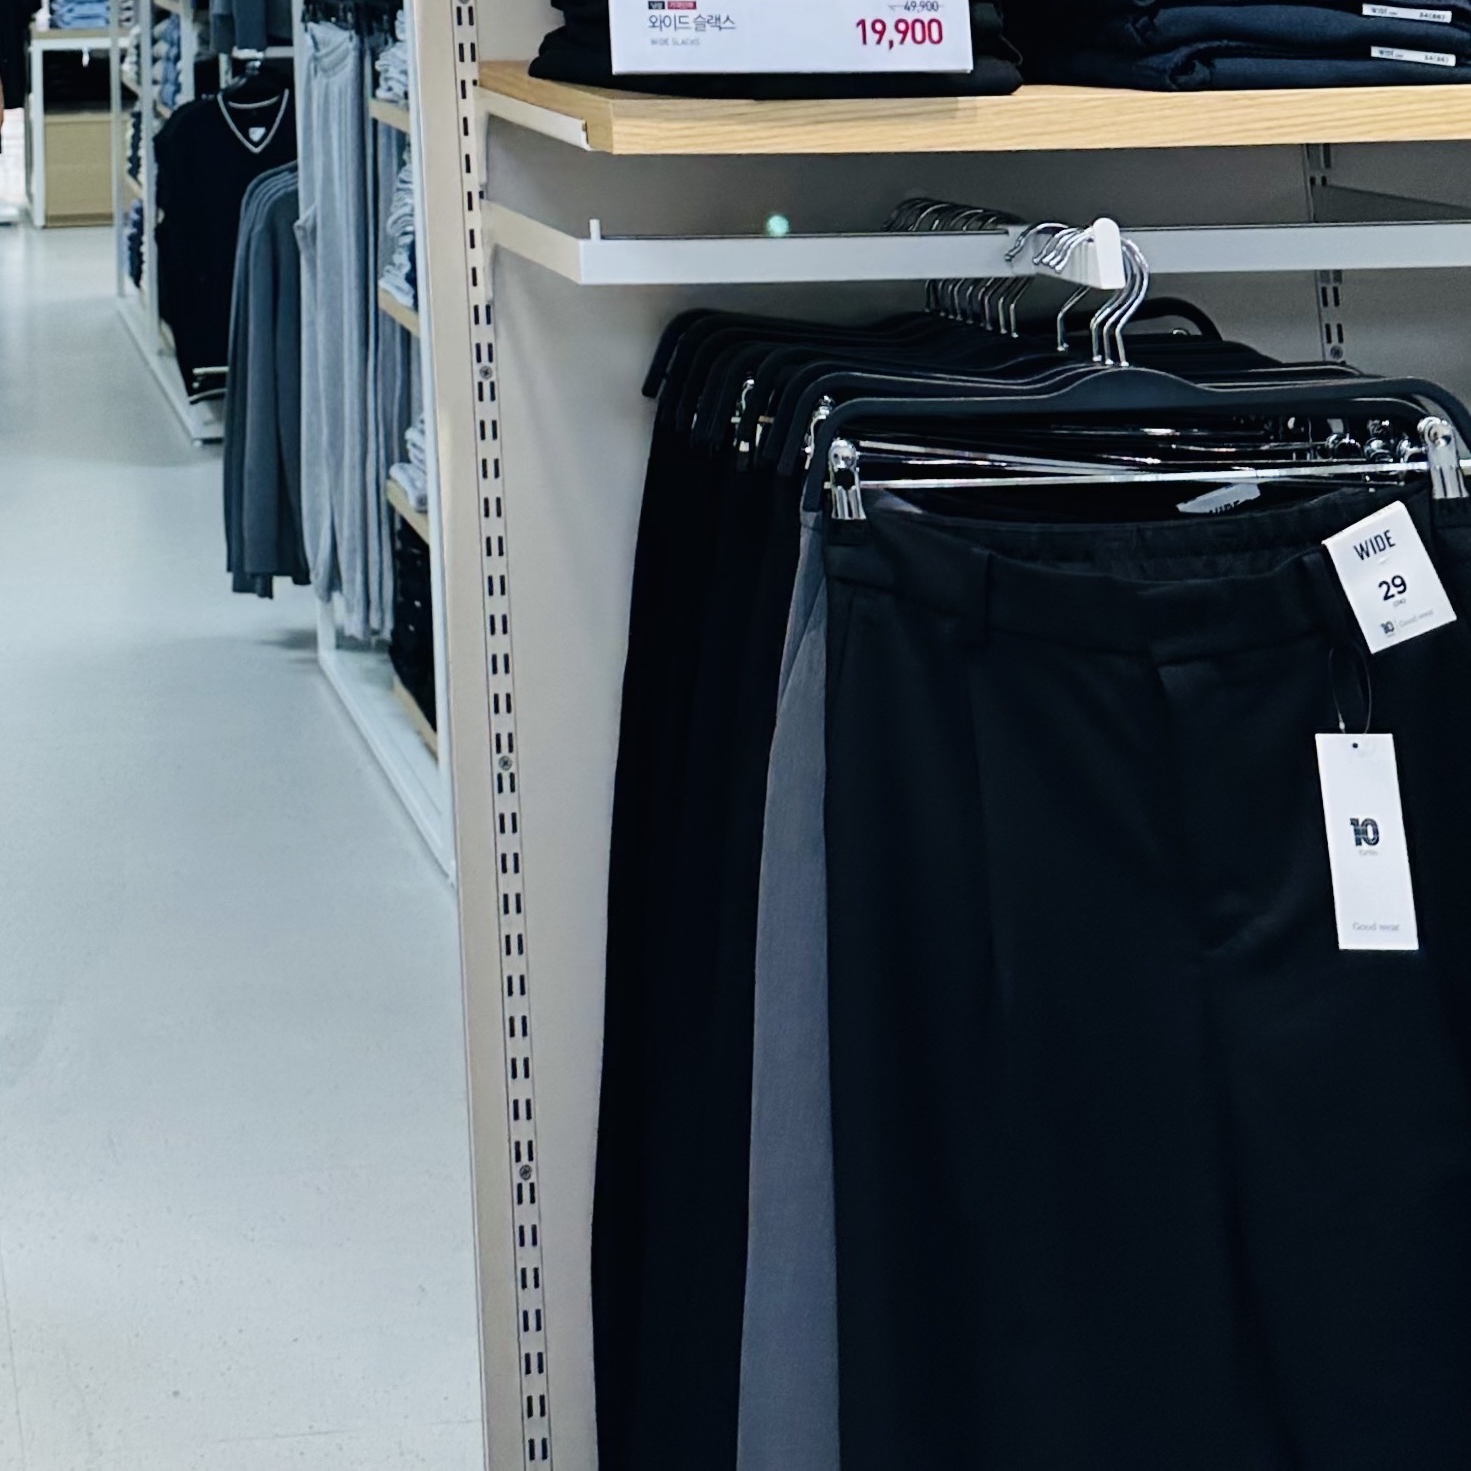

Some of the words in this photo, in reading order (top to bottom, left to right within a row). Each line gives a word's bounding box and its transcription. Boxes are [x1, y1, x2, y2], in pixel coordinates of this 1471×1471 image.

[647, 14, 692, 32] 와이드
[856, 18, 943, 51] 19,900
[1354, 530, 1396, 560] WIDE
[1378, 575, 1407, 601] 29
[1349, 817, 1380, 847] 10
